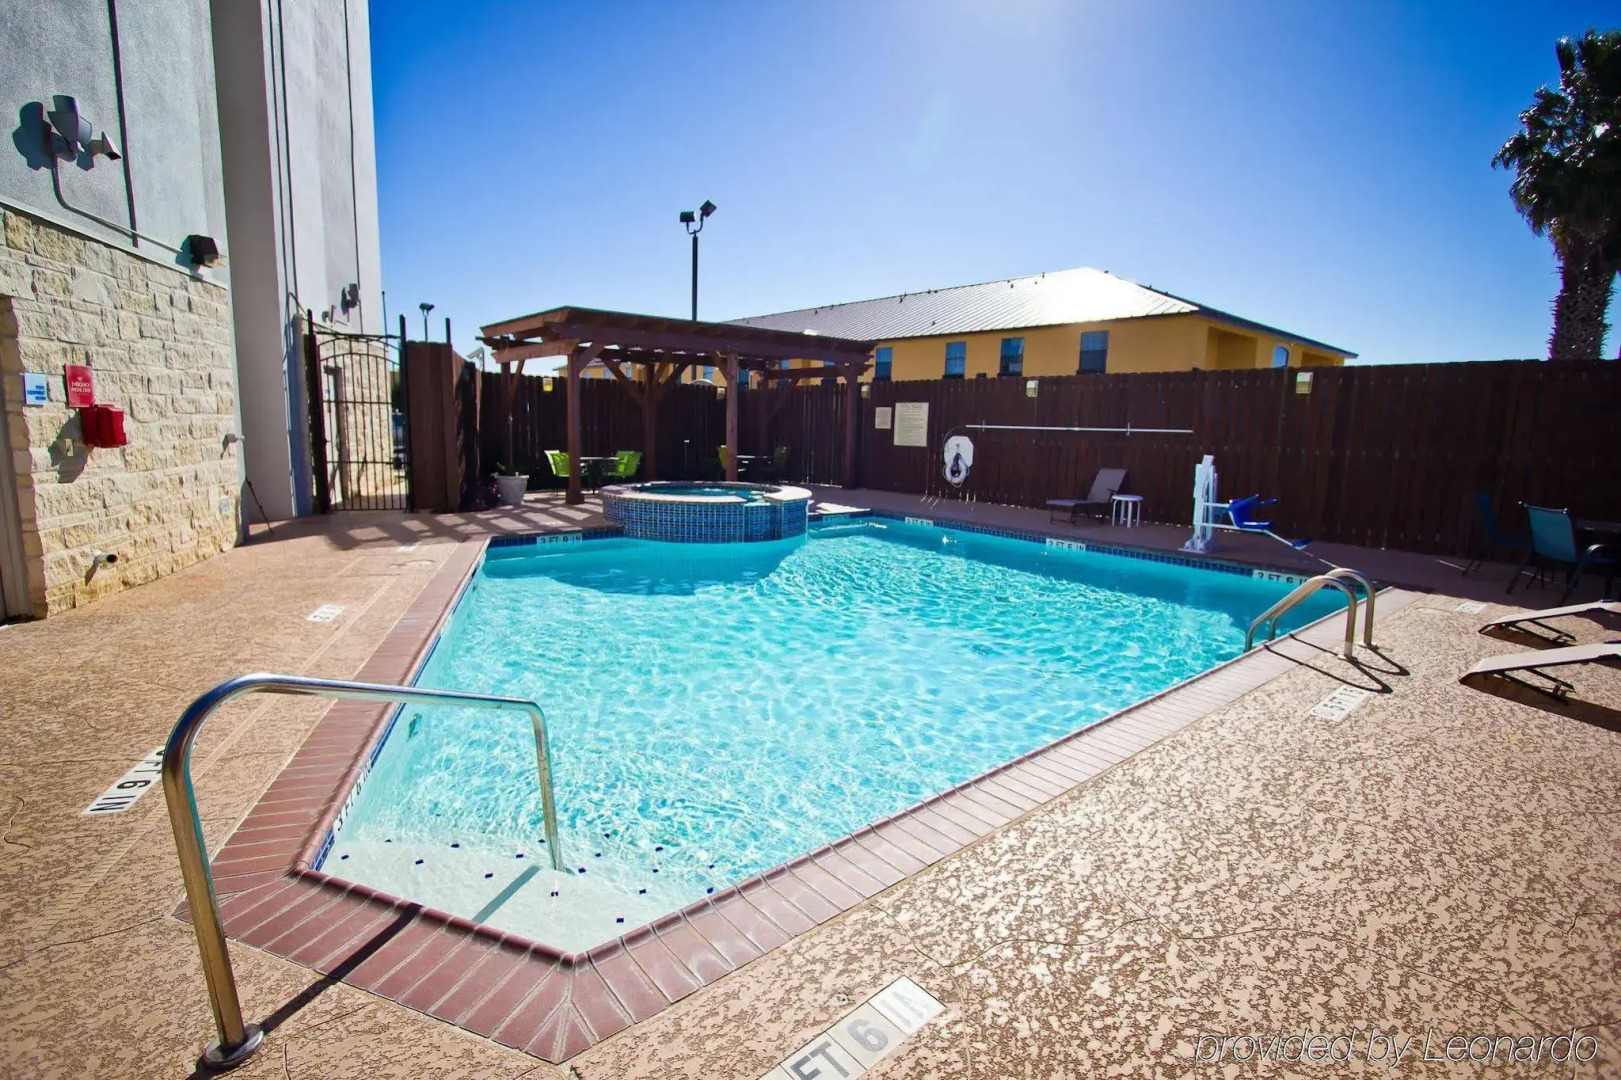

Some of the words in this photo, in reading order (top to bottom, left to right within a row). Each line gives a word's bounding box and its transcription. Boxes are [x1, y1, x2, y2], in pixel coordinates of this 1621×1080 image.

[1268, 574, 1282, 582] FT
[89, 795, 137, 812] IN
[790, 1040, 849, 1080] FT
[847, 1018, 888, 1053] 6
